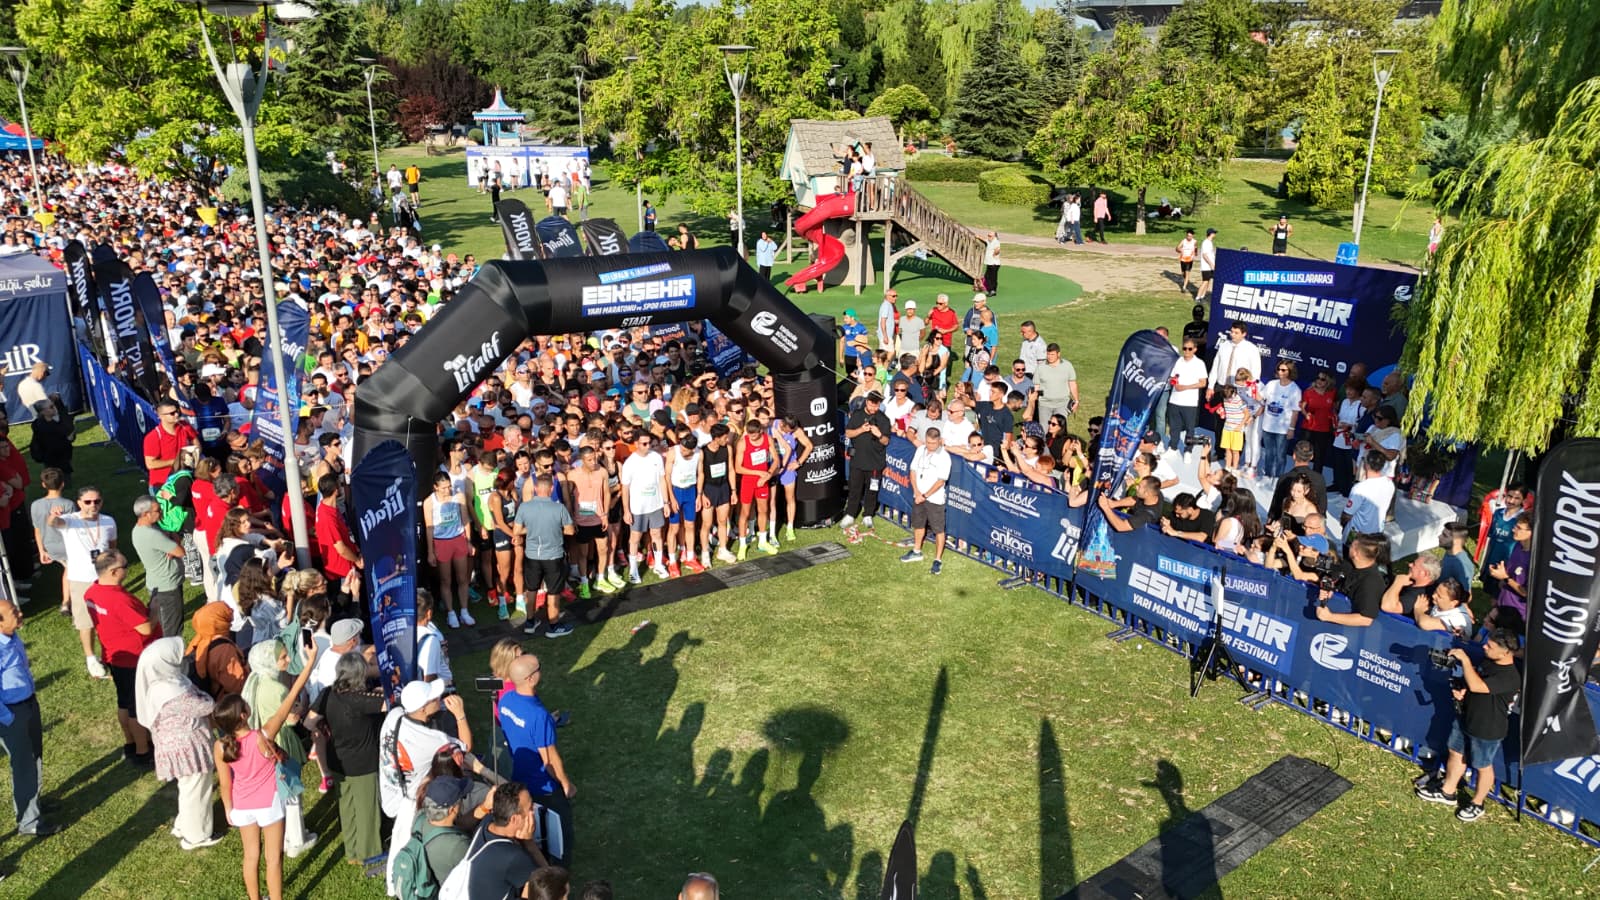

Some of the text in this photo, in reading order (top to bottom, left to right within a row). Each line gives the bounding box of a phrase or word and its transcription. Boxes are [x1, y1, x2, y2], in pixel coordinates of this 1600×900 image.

[581, 277, 693, 306] ESKİŞEHİR
[1219, 283, 1354, 327] ESKİŞEHİR
[620, 316, 654, 328] START
[1309, 356, 1330, 369] TCL
[804, 421, 835, 437] TCL
[882, 477, 901, 495] Var.
[993, 484, 1039, 512] KALABAK
[1549, 469, 1600, 577] WORK
[990, 529, 1033, 556] ankara
[1542, 579, 1590, 646] JUST
[1132, 593, 1152, 611] YARI
[1152, 601, 1200, 632] MARATONU
[1232, 639, 1280, 666] FESTİVALİ
[1358, 658, 1411, 687] BÜYÜKŞEHİR
[1359, 648, 1402, 672] ESKİŞEHİR
[1356, 668, 1402, 694] BELEDİYESİ
